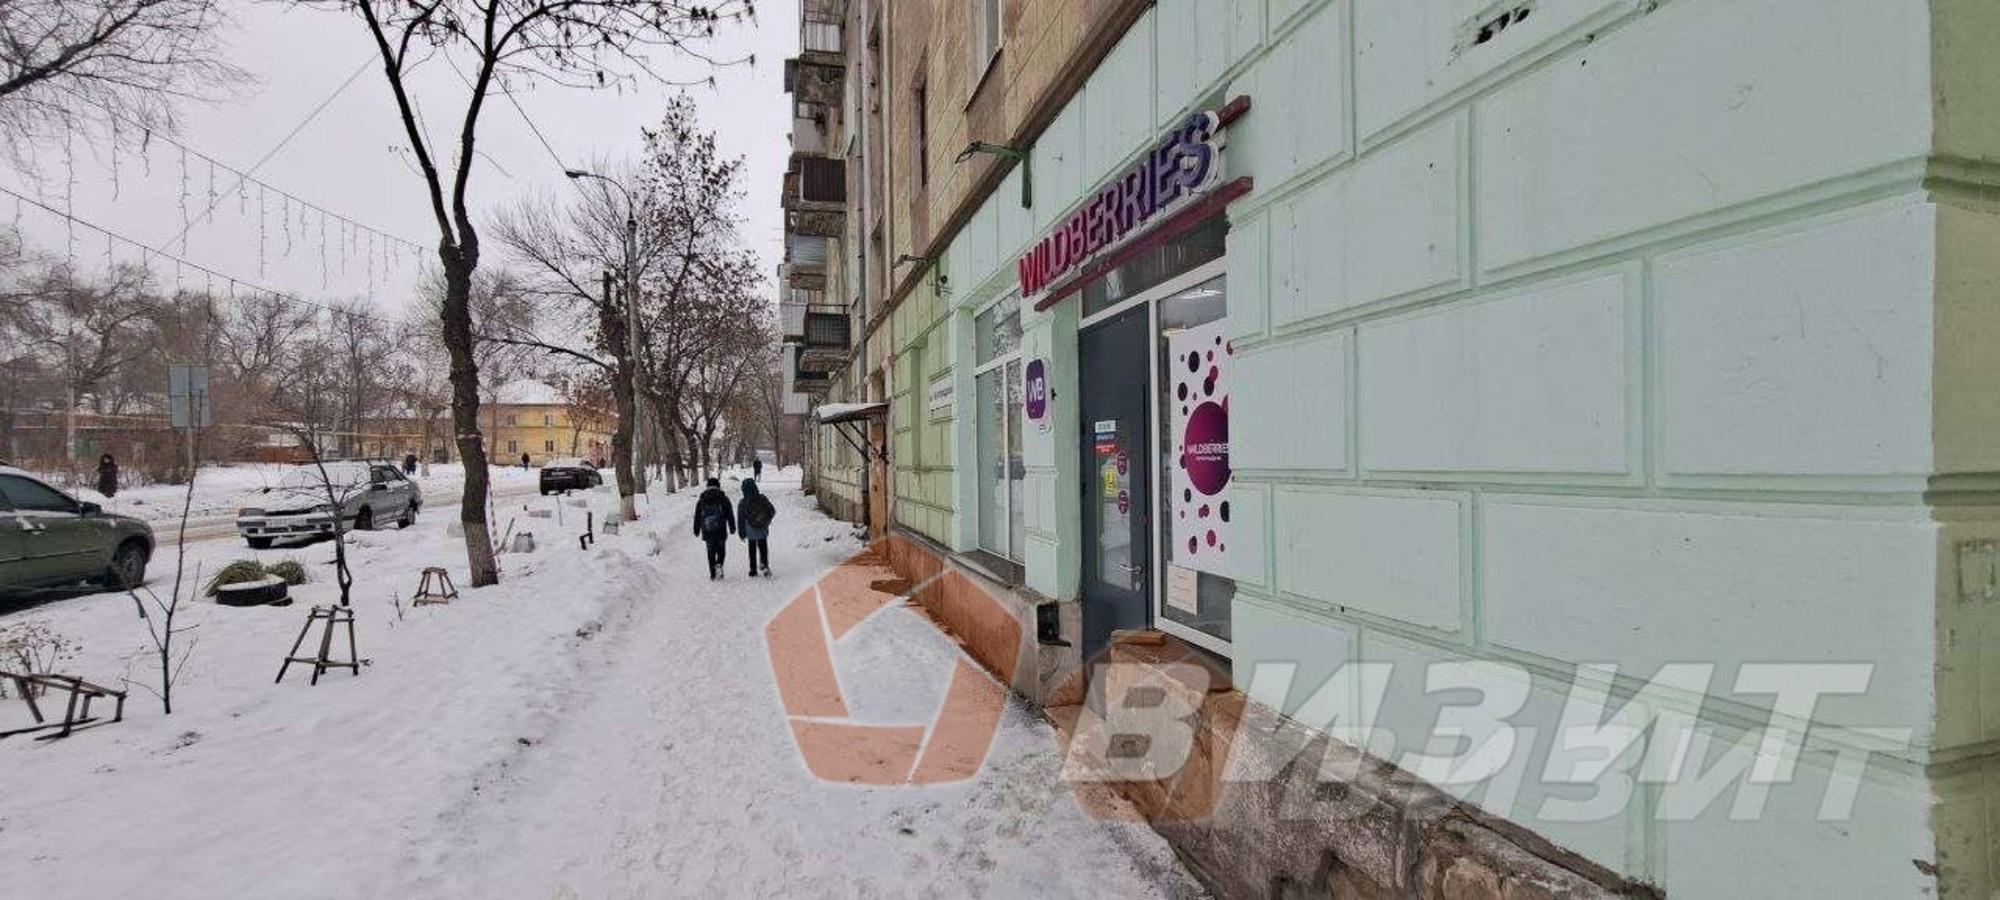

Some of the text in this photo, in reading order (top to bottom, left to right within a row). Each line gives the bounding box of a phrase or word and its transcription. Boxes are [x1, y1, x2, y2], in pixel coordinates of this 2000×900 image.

[1019, 111, 1220, 298] WILDBERRIES
[1027, 377, 1043, 402] WB
[1186, 442, 1229, 455] WILDBERRIE
